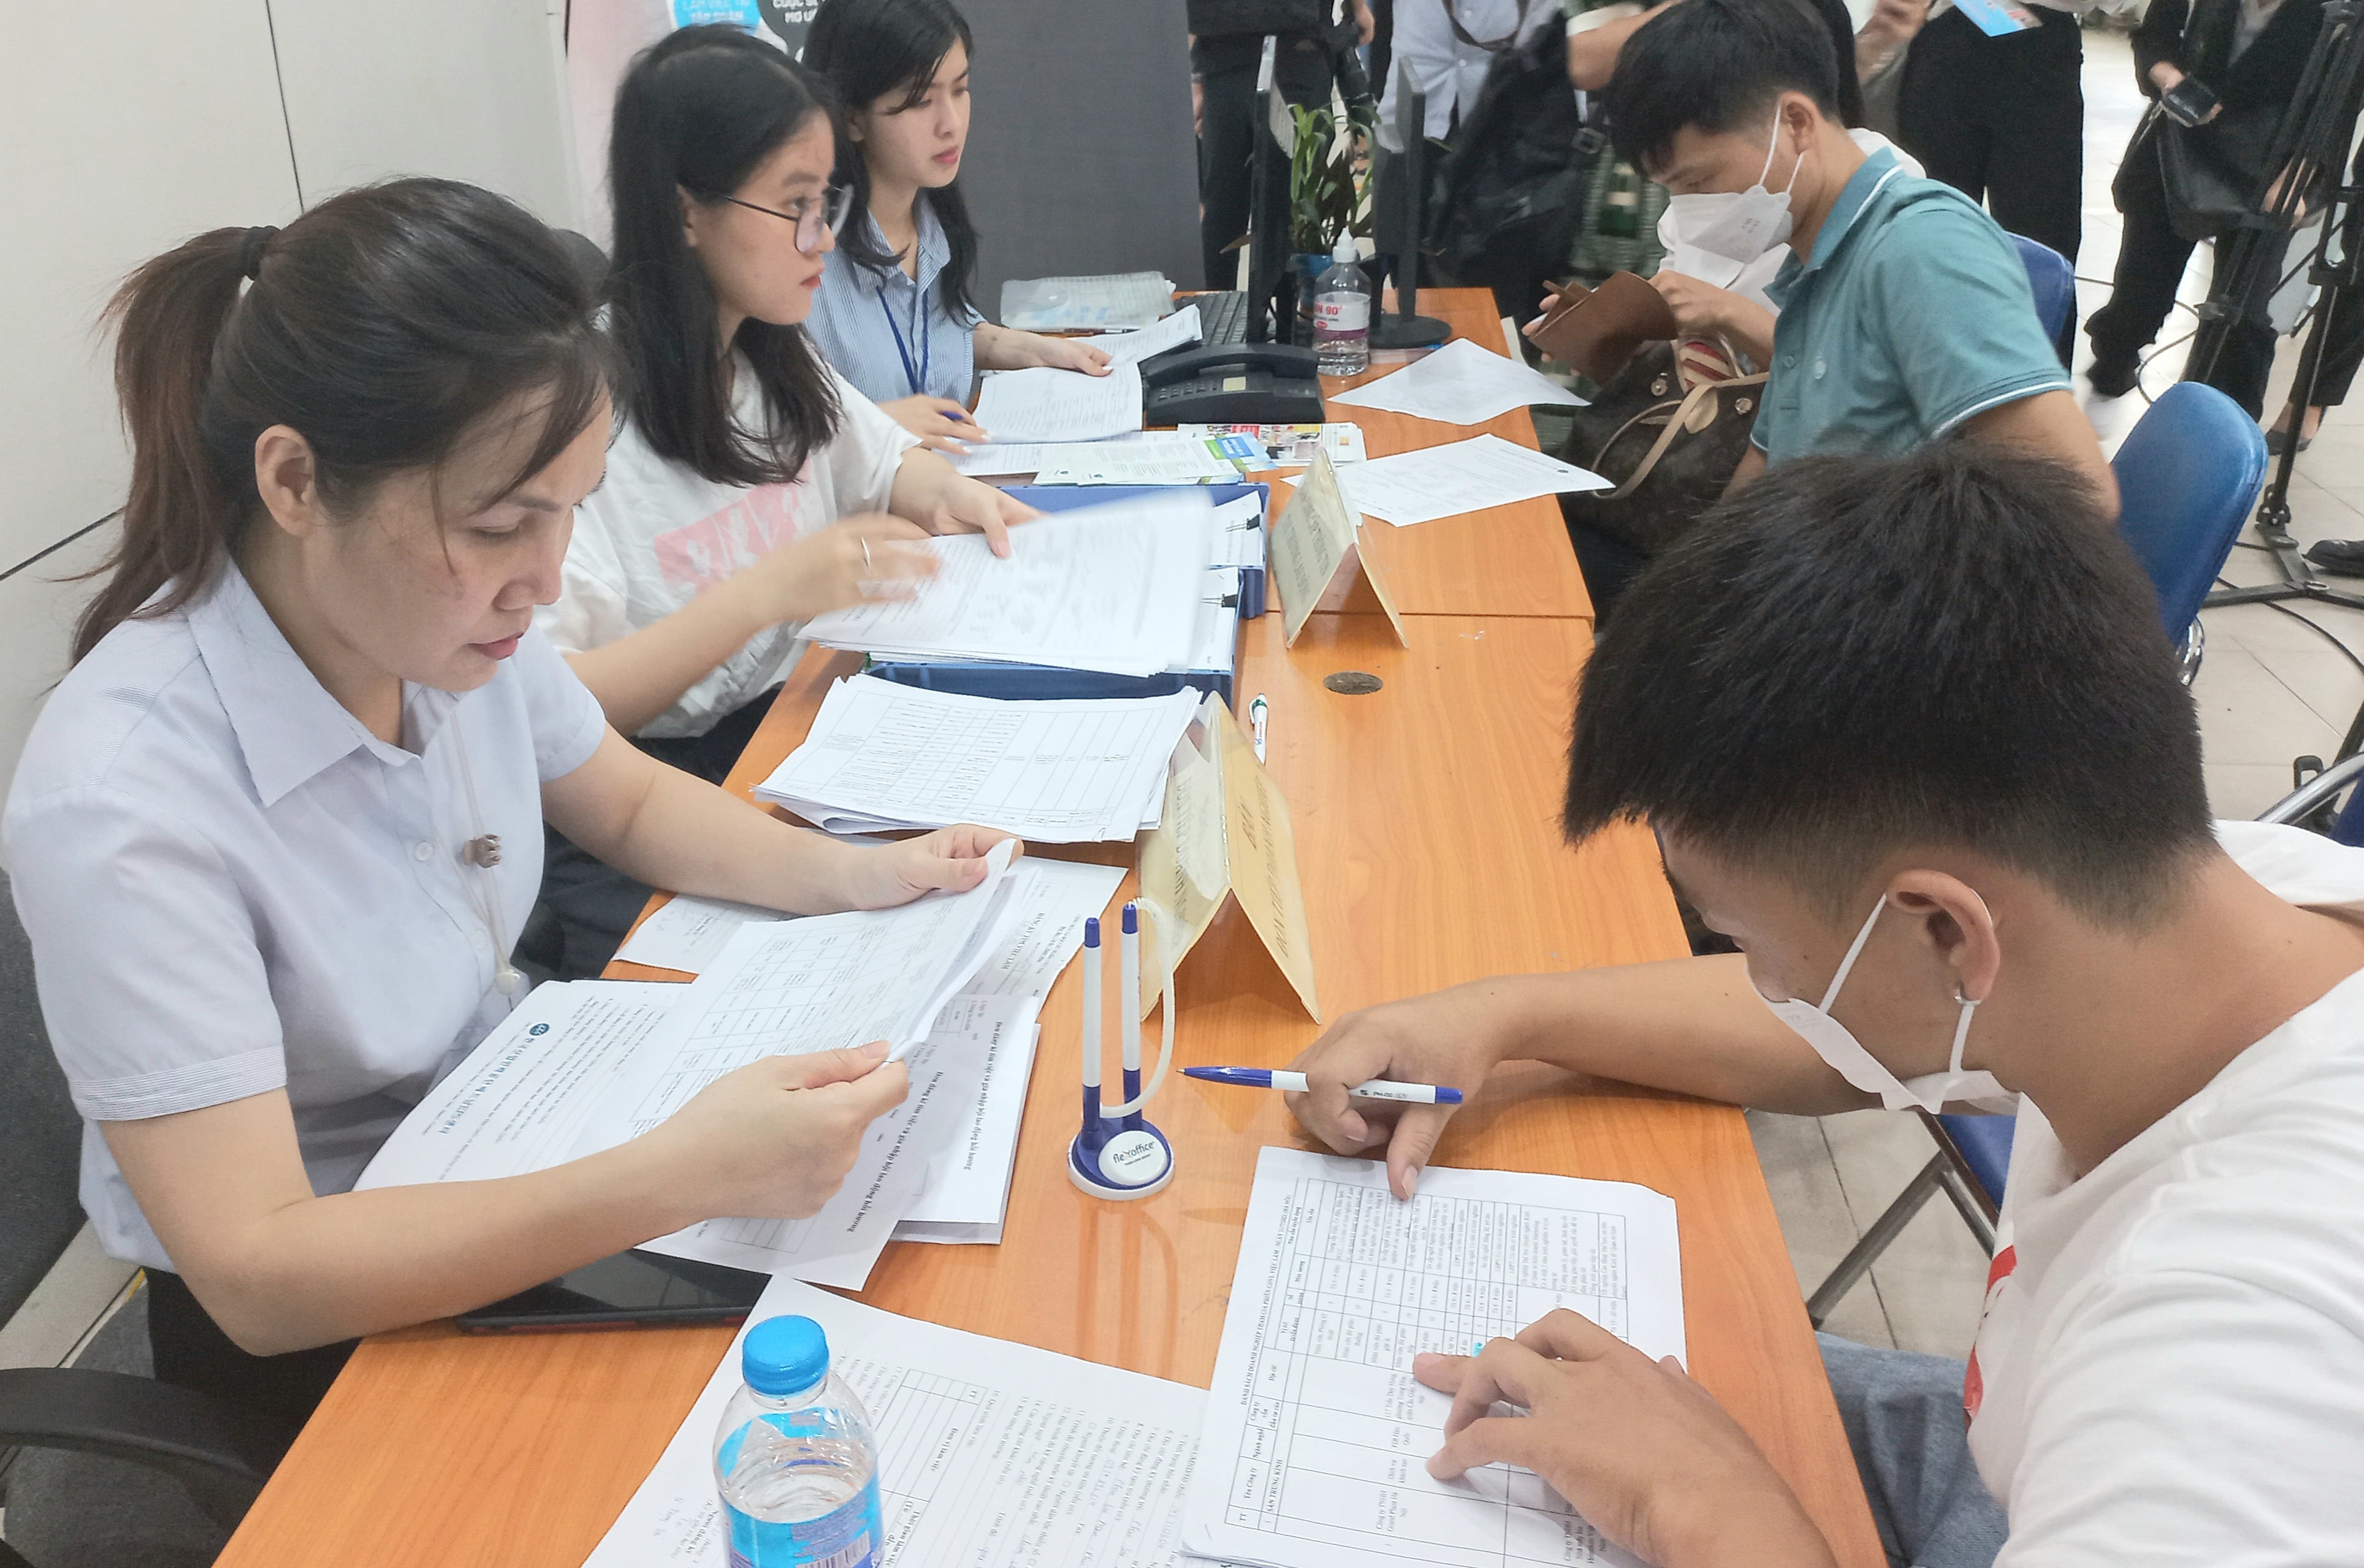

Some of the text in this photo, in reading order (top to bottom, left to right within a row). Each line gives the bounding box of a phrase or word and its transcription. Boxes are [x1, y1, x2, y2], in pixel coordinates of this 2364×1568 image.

[984, 1063, 993, 1074] việc
[931, 1071, 944, 1083] Đơn
[921, 1083, 936, 1097] đăng
[977, 1092, 988, 1107] nhập
[907, 1115, 918, 1126] việc
[975, 1117, 983, 1126] lao
[896, 1135, 906, 1144] gia
[970, 1127, 982, 1141] động
[887, 1145, 901, 1161] nhập
[876, 1172, 888, 1182] lao
[865, 1183, 880, 1200] động
[1269, 1477, 1279, 1498] TRUNG
[1052, 1490, 1067, 1508] Người
[1047, 1509, 1058, 1520] dân
[690, 1529, 706, 1545] đăng
[885, 1511, 921, 1567] Thời gian làm việc
